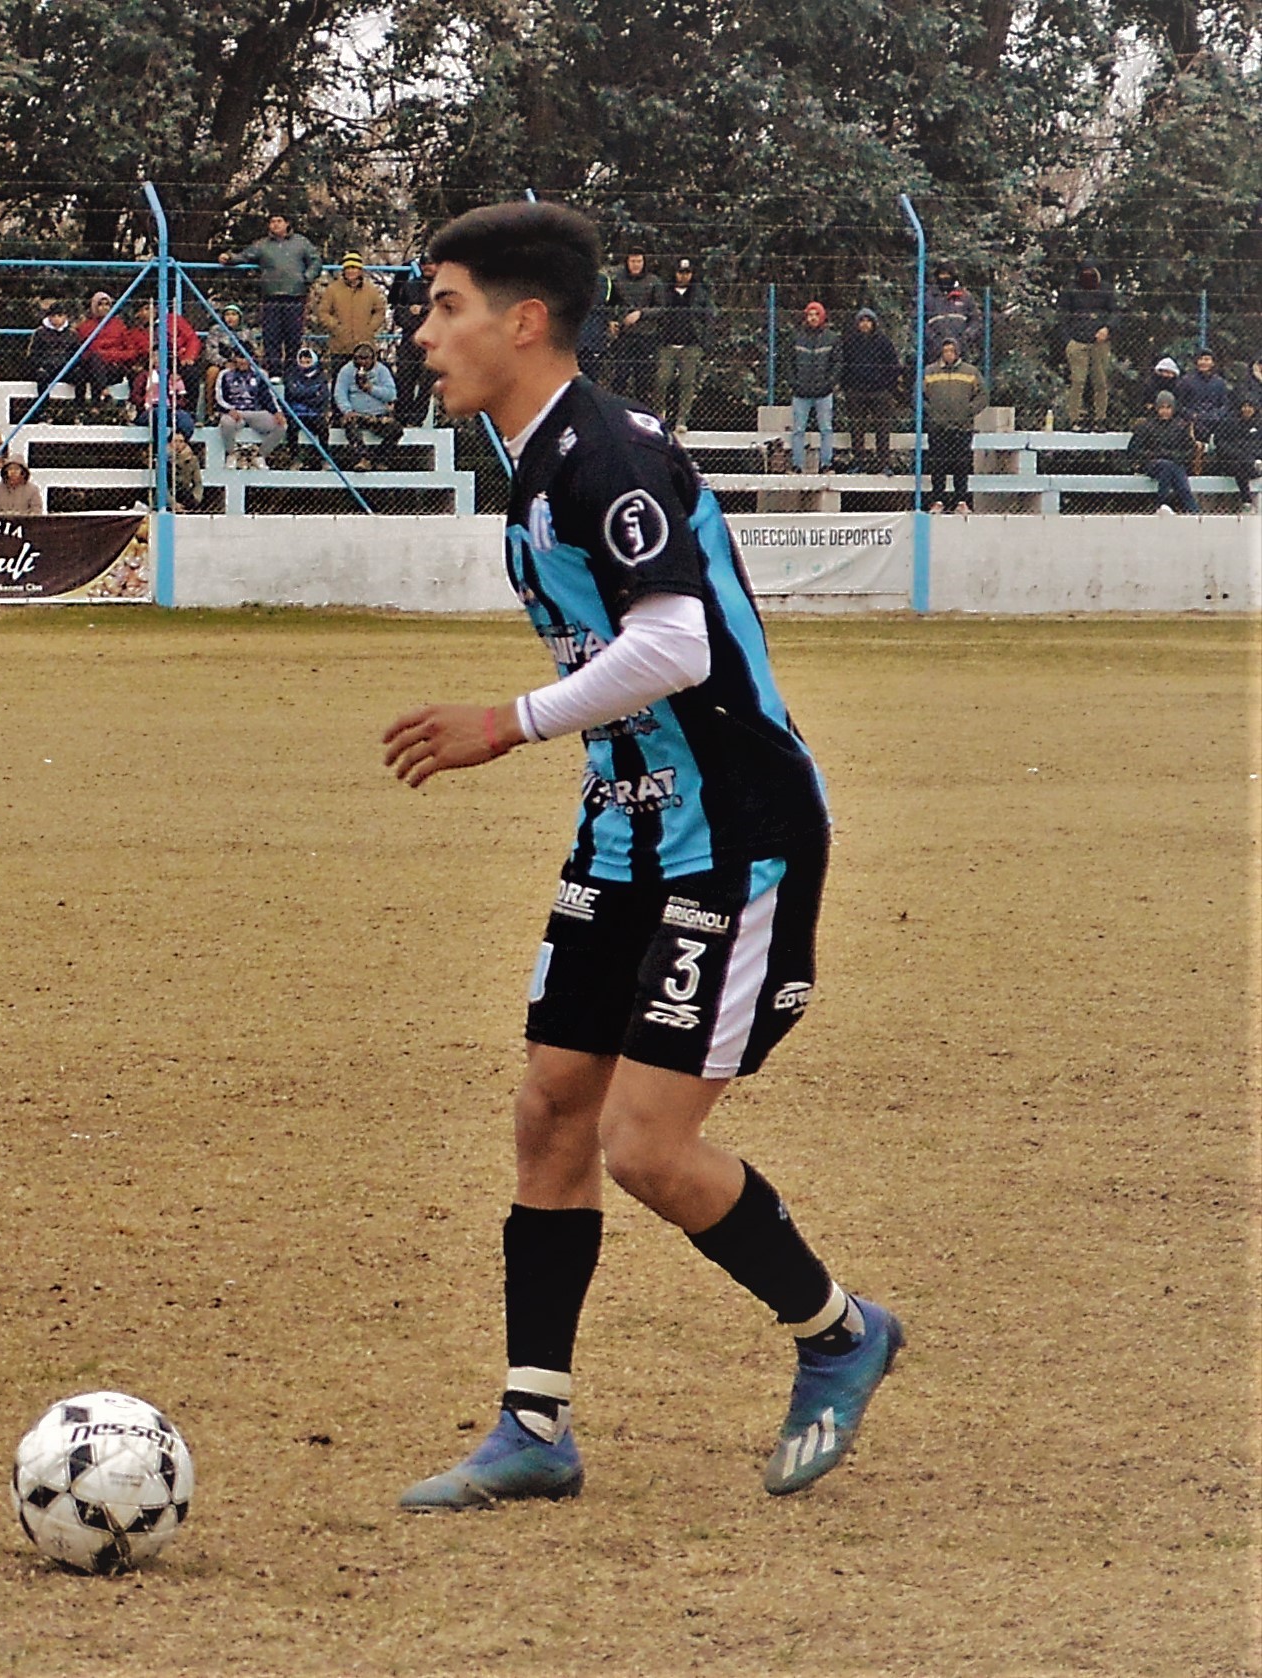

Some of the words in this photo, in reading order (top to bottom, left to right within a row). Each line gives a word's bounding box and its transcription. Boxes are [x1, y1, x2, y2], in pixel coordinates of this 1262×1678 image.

[740, 526, 806, 546] DIRECCIÓN
[810, 529, 826, 546] DE
[829, 528, 893, 546] DEPORTES
[663, 903, 730, 929] BRIGNOLI
[663, 937, 708, 1002] 3
